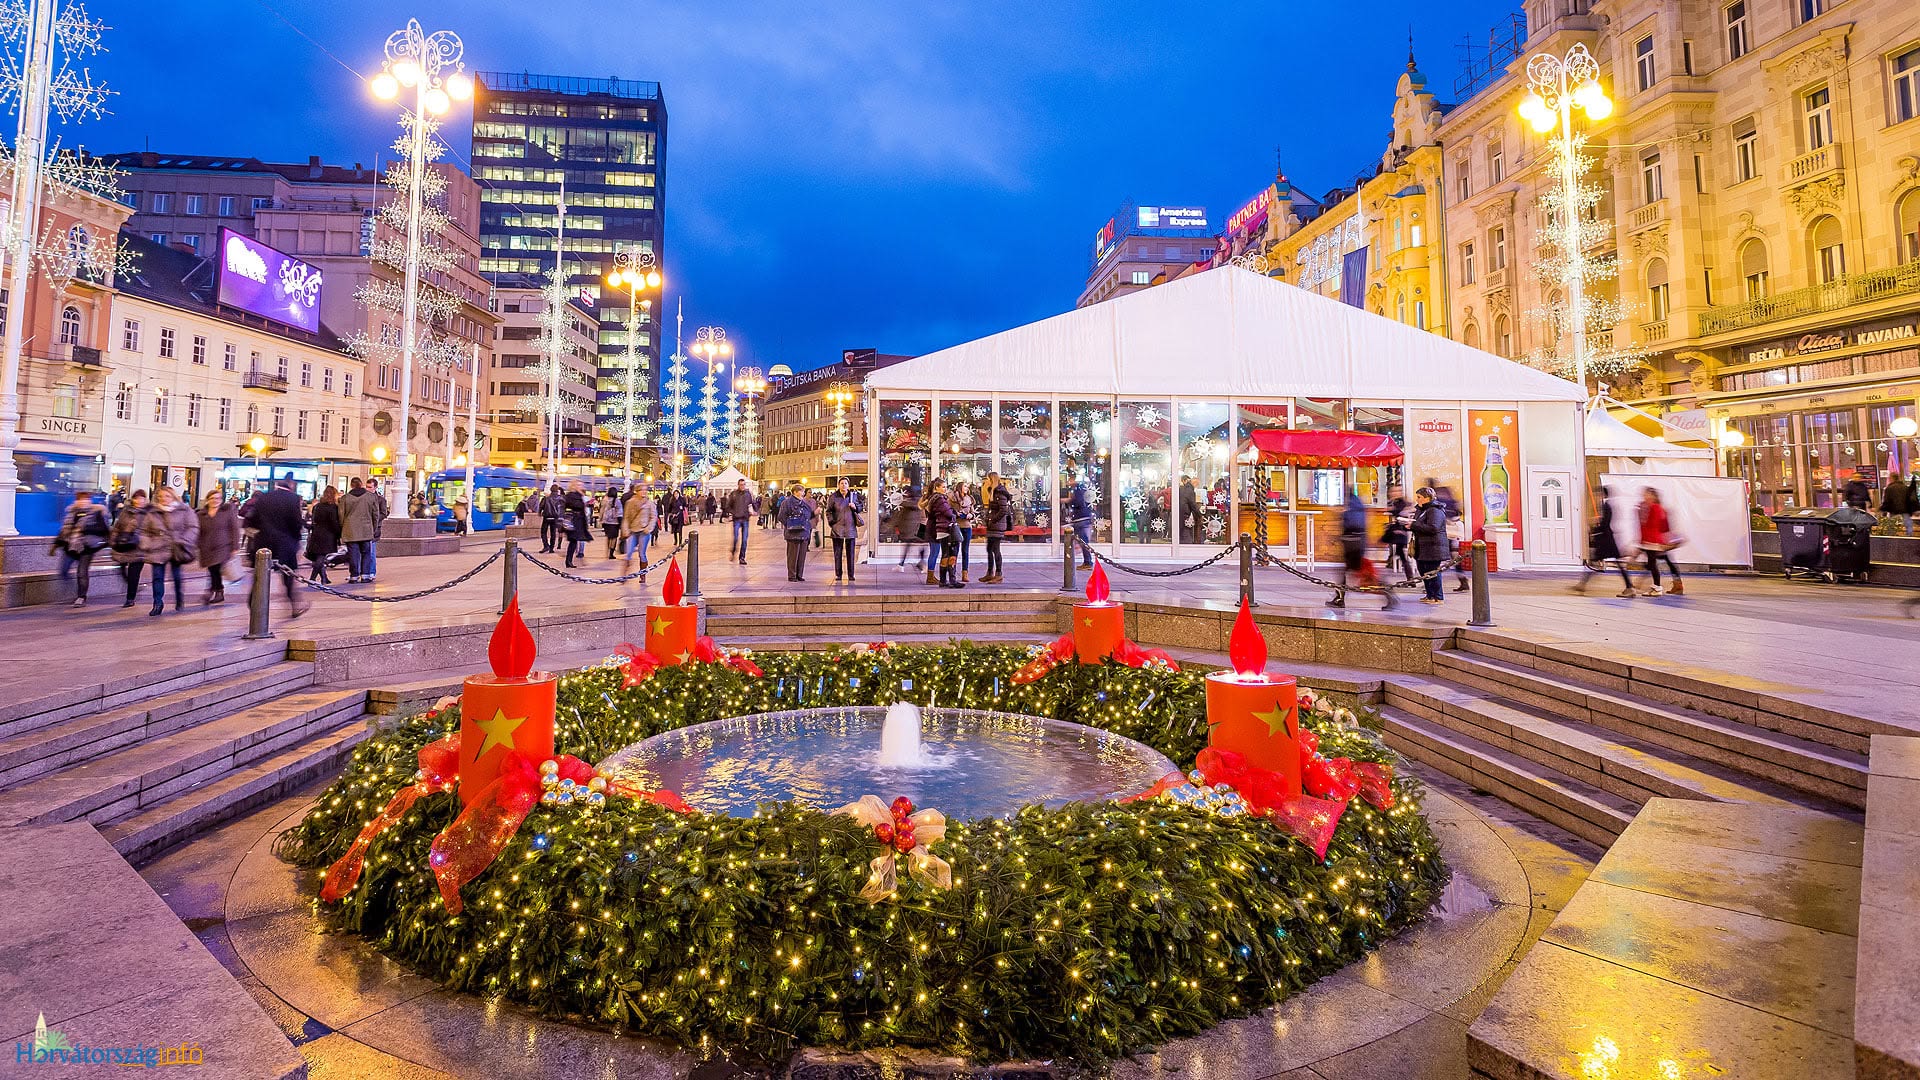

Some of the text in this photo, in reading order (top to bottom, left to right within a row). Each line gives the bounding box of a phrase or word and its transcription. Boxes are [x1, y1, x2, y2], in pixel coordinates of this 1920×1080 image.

[1159, 207, 1203, 217] American
[1169, 217, 1207, 226] Express
[1228, 199, 1258, 235] PARTNER
[1749, 325, 1916, 364] BEČKA Aida KAVANA
[783, 372, 812, 389] SPLITSKA
[813, 365, 837, 382] BANKA
[41, 419, 87, 434] SINGER
